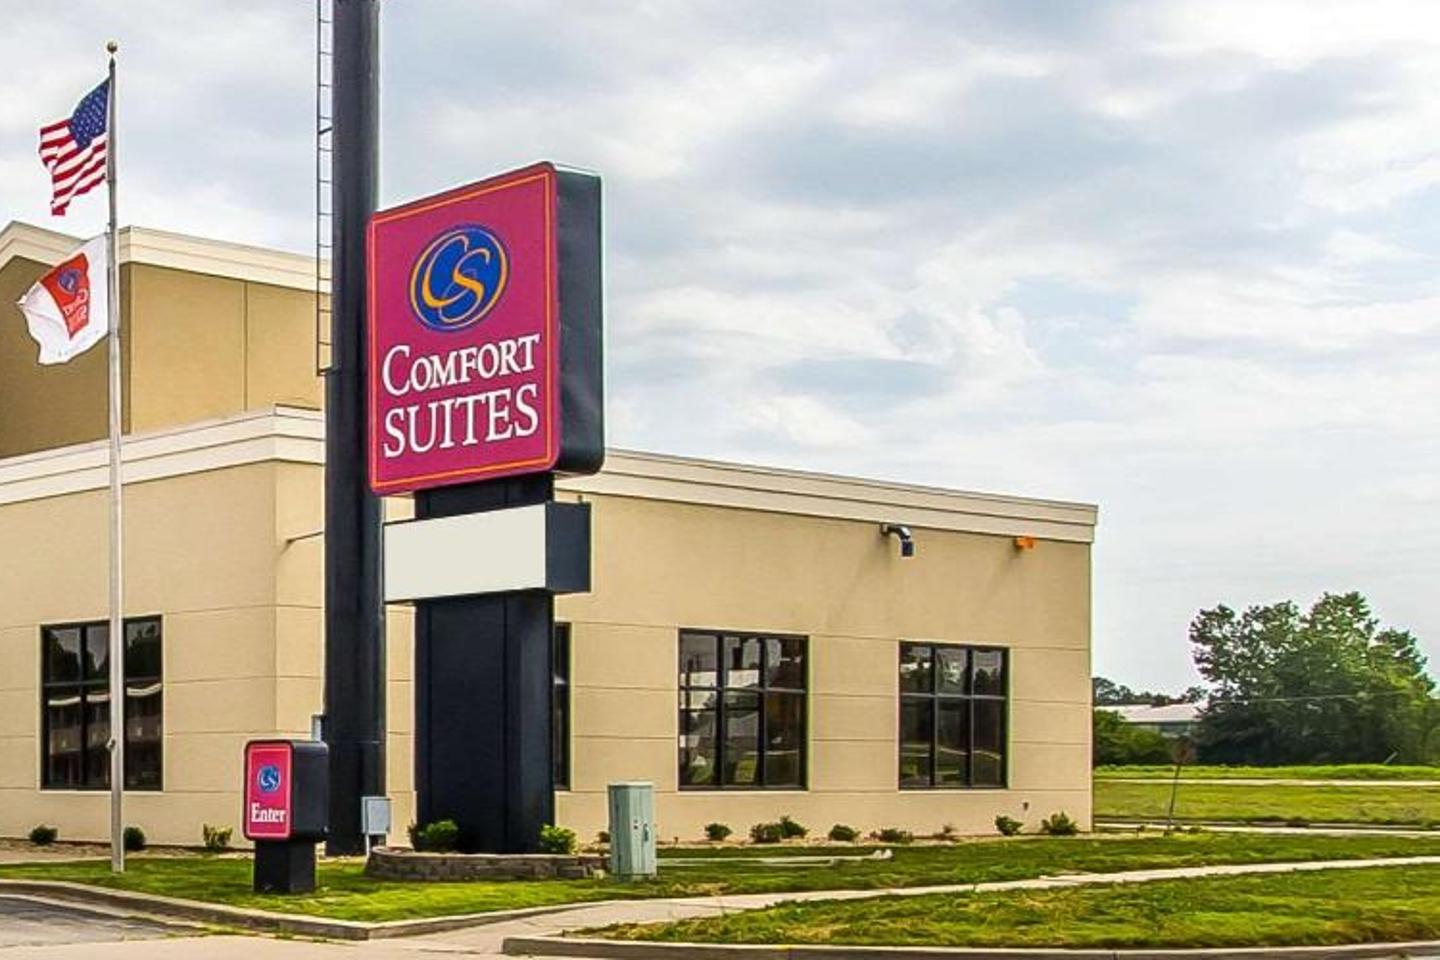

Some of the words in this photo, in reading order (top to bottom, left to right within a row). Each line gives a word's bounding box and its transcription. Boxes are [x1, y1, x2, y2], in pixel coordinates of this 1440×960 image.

[382, 333, 541, 397] COMFORT
[383, 383, 538, 458] SUITES
[251, 802, 286, 823] Enter
